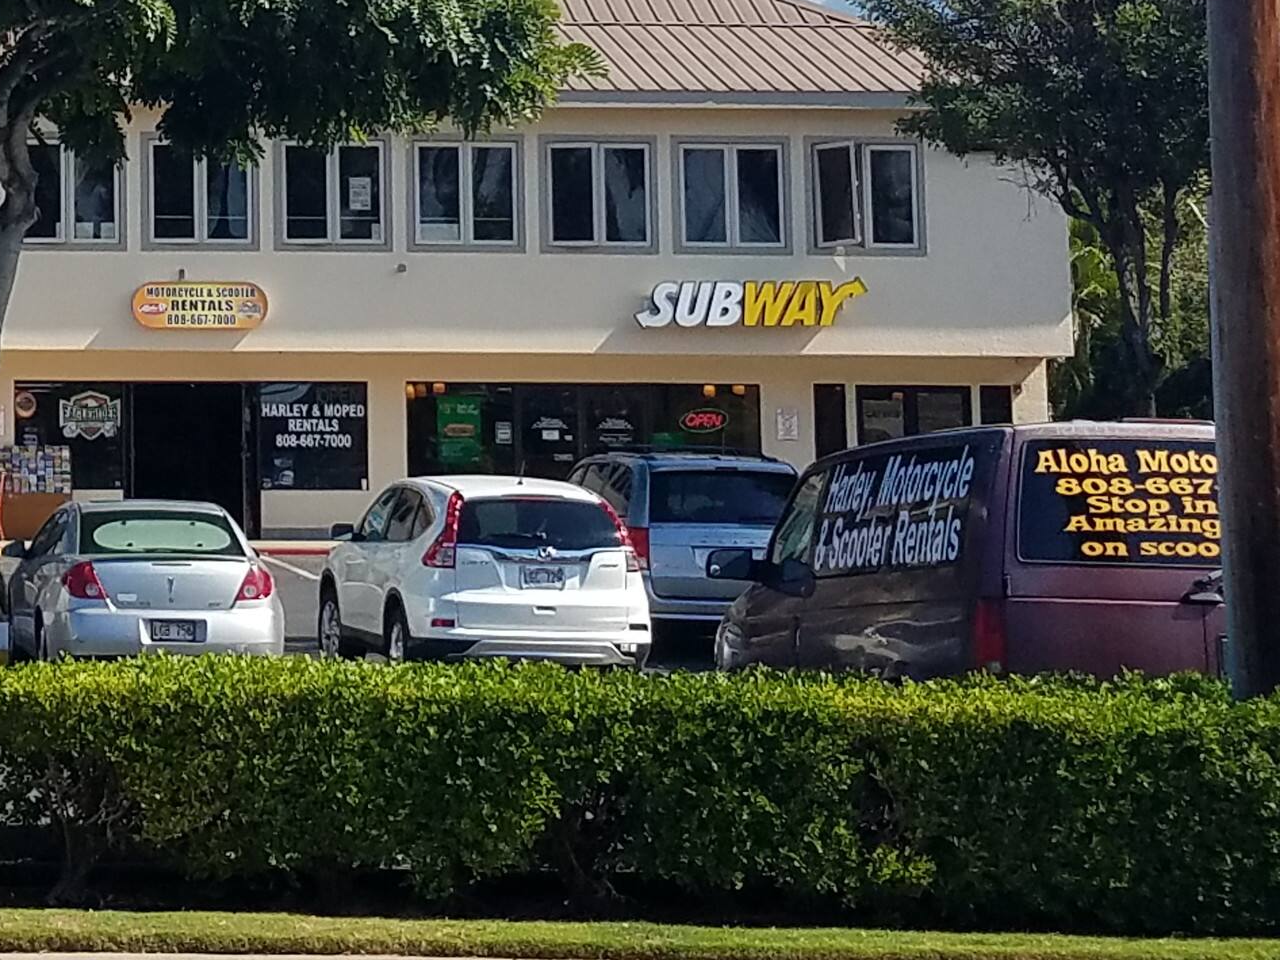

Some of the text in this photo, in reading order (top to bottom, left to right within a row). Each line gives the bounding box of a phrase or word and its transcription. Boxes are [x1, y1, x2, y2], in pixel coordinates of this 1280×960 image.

[145, 287, 256, 298] MOTORCYCLE & SCOOTER
[170, 299, 235, 312] RENTALS
[634, 276, 869, 328] SUBWAY
[167, 314, 237, 325] 808-667-7000
[261, 403, 365, 418] HARLEY & MOPED
[287, 418, 340, 432] RENTALS
[685, 413, 723, 428] OPEN
[275, 433, 353, 448] 808-667-7000
[1034, 448, 1218, 475] Aloha Moto
[876, 443, 975, 517] Motorcycle
[1086, 495, 1219, 517] Stop in
[1063, 514, 1221, 540] Amazing
[814, 504, 962, 571] & Scooter Rentals
[1080, 541, 1221, 557] on scoo
